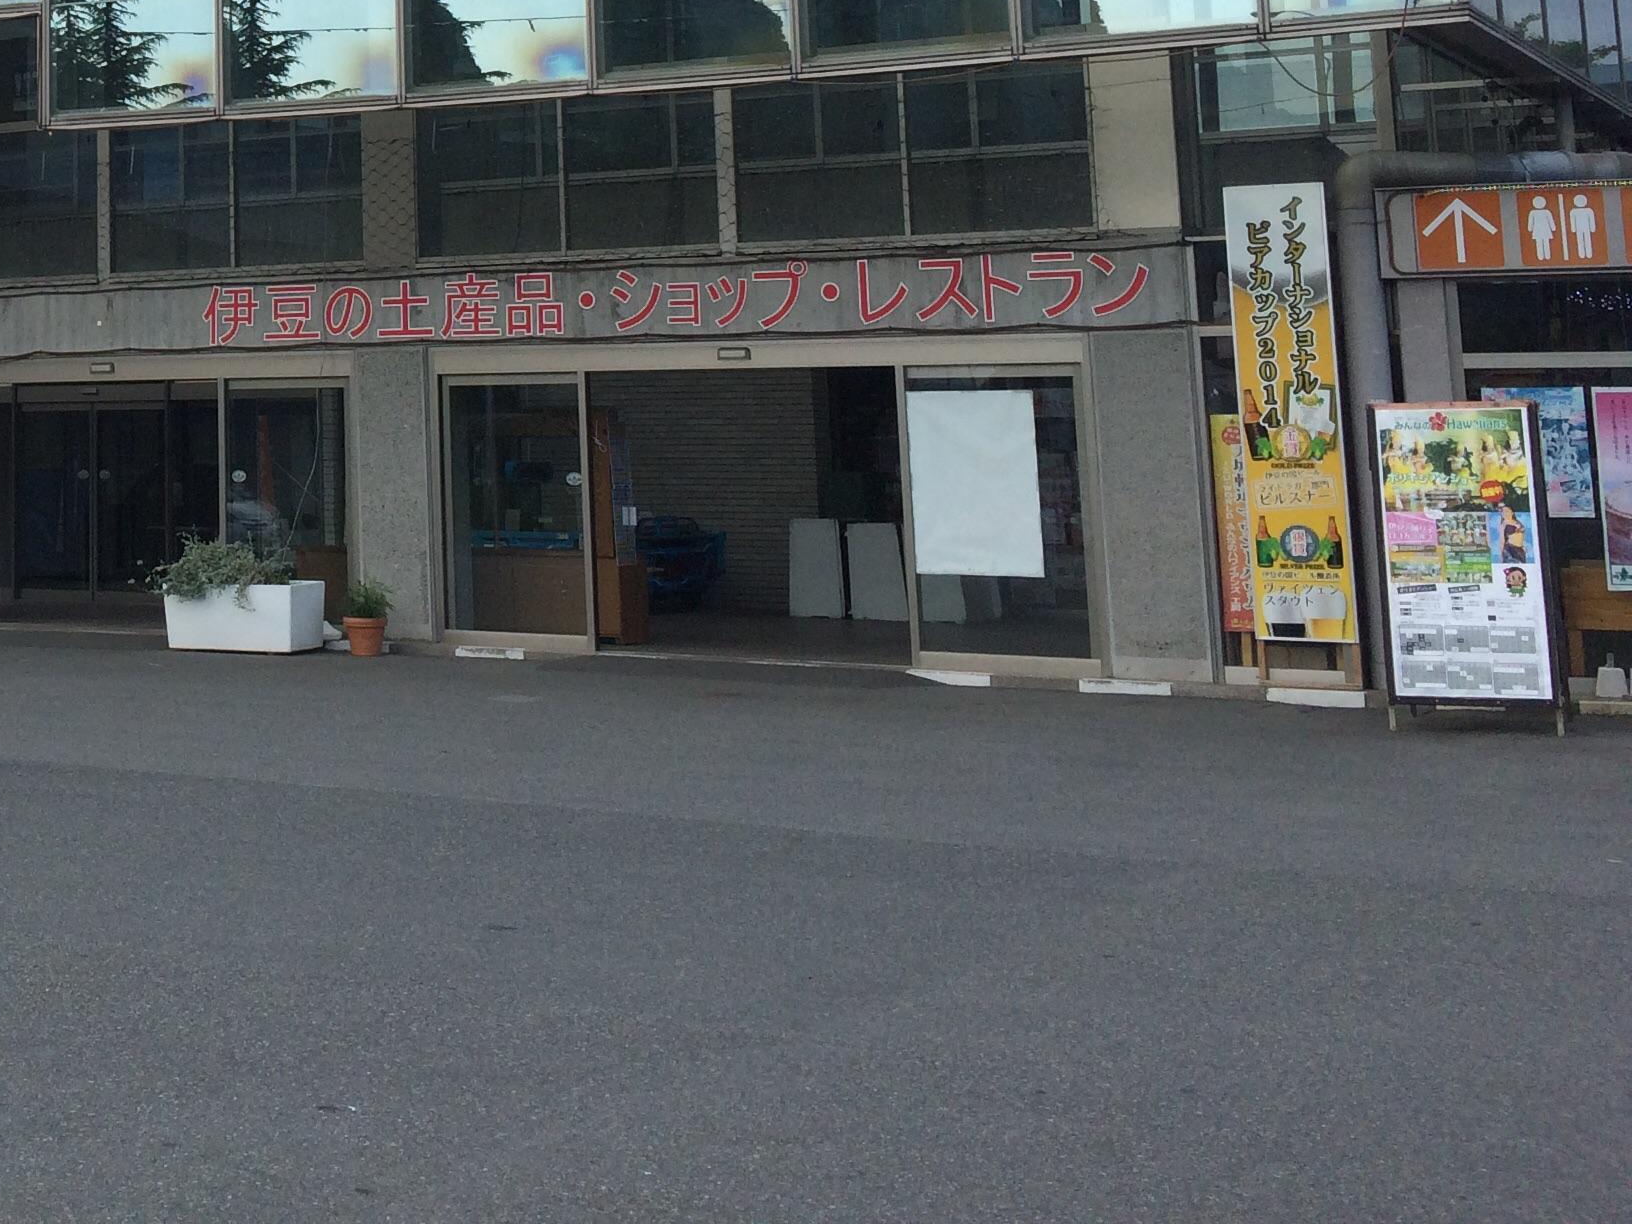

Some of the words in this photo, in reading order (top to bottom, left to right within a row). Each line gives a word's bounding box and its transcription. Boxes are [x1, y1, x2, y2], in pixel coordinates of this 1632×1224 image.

[202, 251, 1149, 346] 伊豆の土産品・ショップ・レストラン
[1245, 220, 1282, 428] ビアカップ2014
[1279, 196, 1319, 395] インターナショナル
